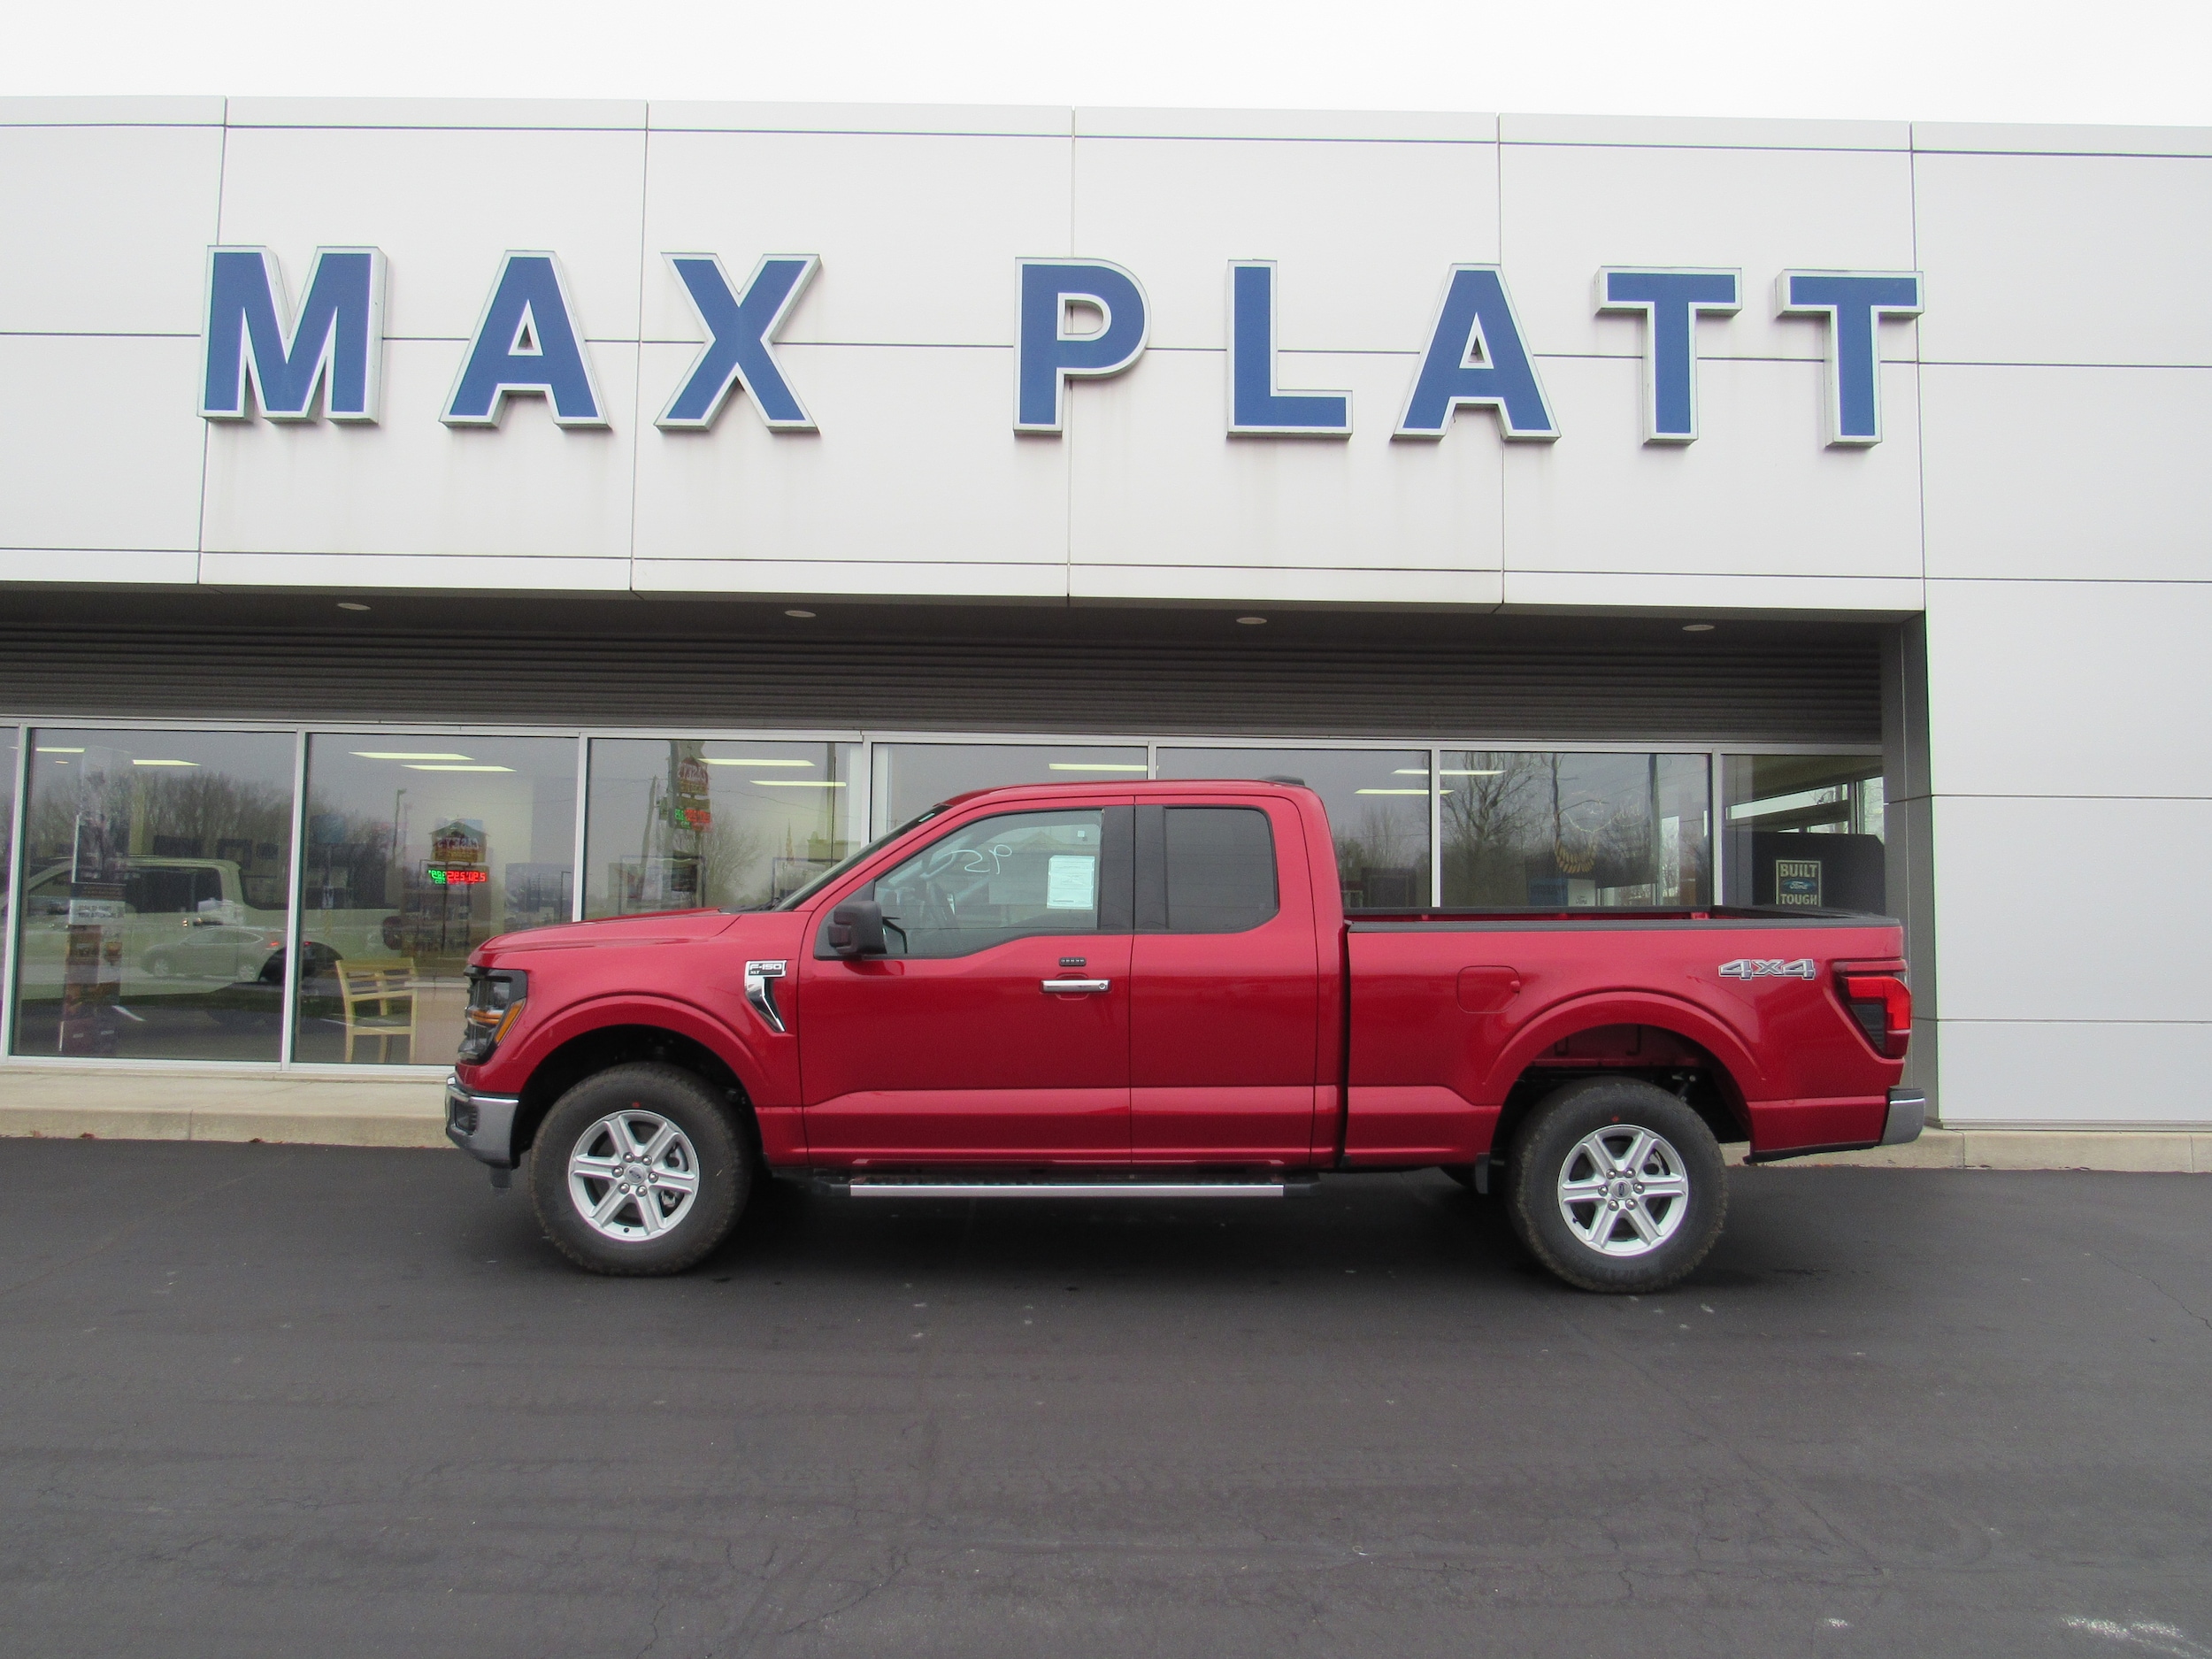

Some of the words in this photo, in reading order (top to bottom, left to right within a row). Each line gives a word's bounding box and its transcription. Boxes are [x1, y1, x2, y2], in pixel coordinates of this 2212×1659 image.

[196, 245, 821, 434] MAX
[1013, 257, 1924, 447] PLATT
[1780, 864, 1817, 878] BUILT
[1789, 880, 1808, 890] Ford
[1780, 894, 1817, 905] TOUGH
